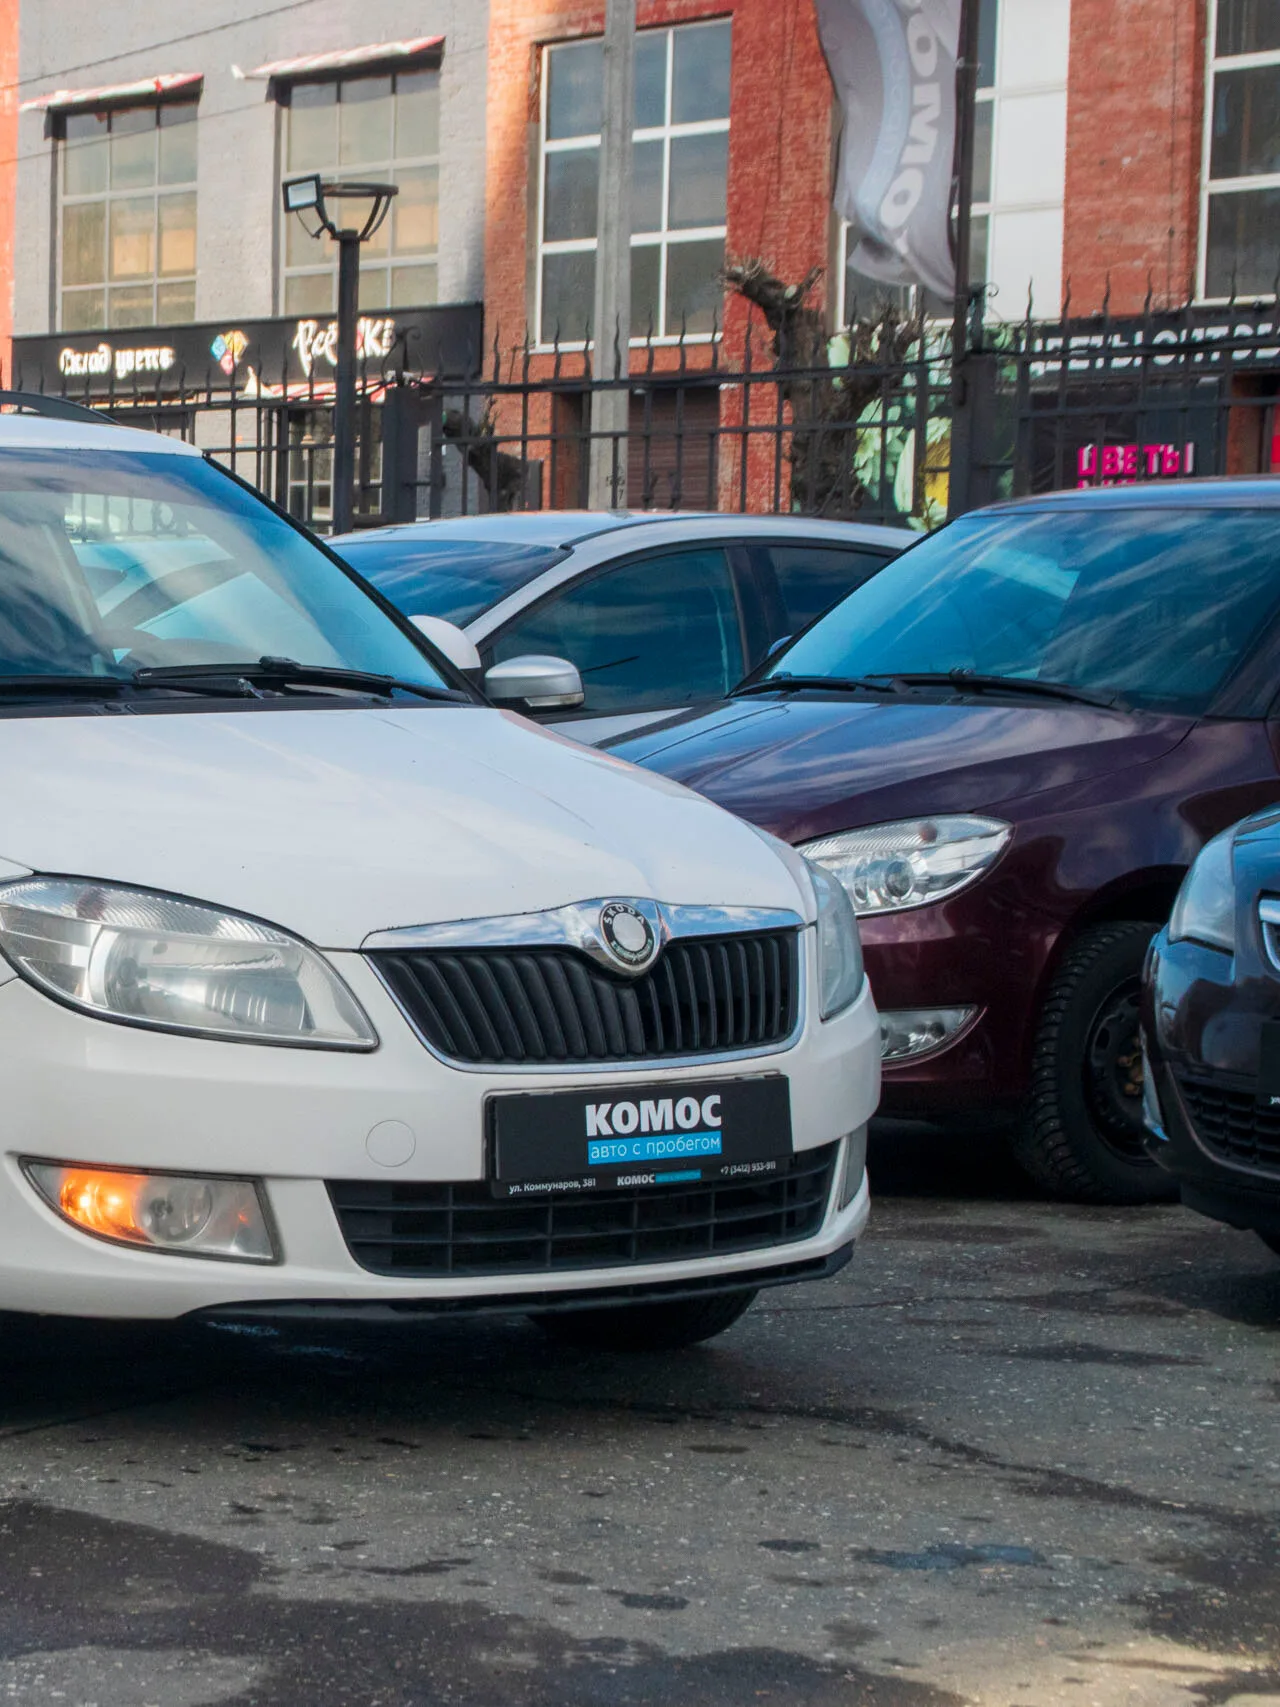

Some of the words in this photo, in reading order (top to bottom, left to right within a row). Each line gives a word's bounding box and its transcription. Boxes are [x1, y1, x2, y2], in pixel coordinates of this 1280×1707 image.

[58, 343, 113, 377] Склад
[1078, 443, 1194, 476] ЦВЕТЫ
[586, 1095, 722, 1137] КОМОС
[591, 1144, 627, 1159] авто
[632, 1143, 641, 1155] с
[646, 1136, 720, 1157] пробегом
[524, 1181, 581, 1192] Коммунаров,
[617, 1174, 656, 1187] КОМОС
